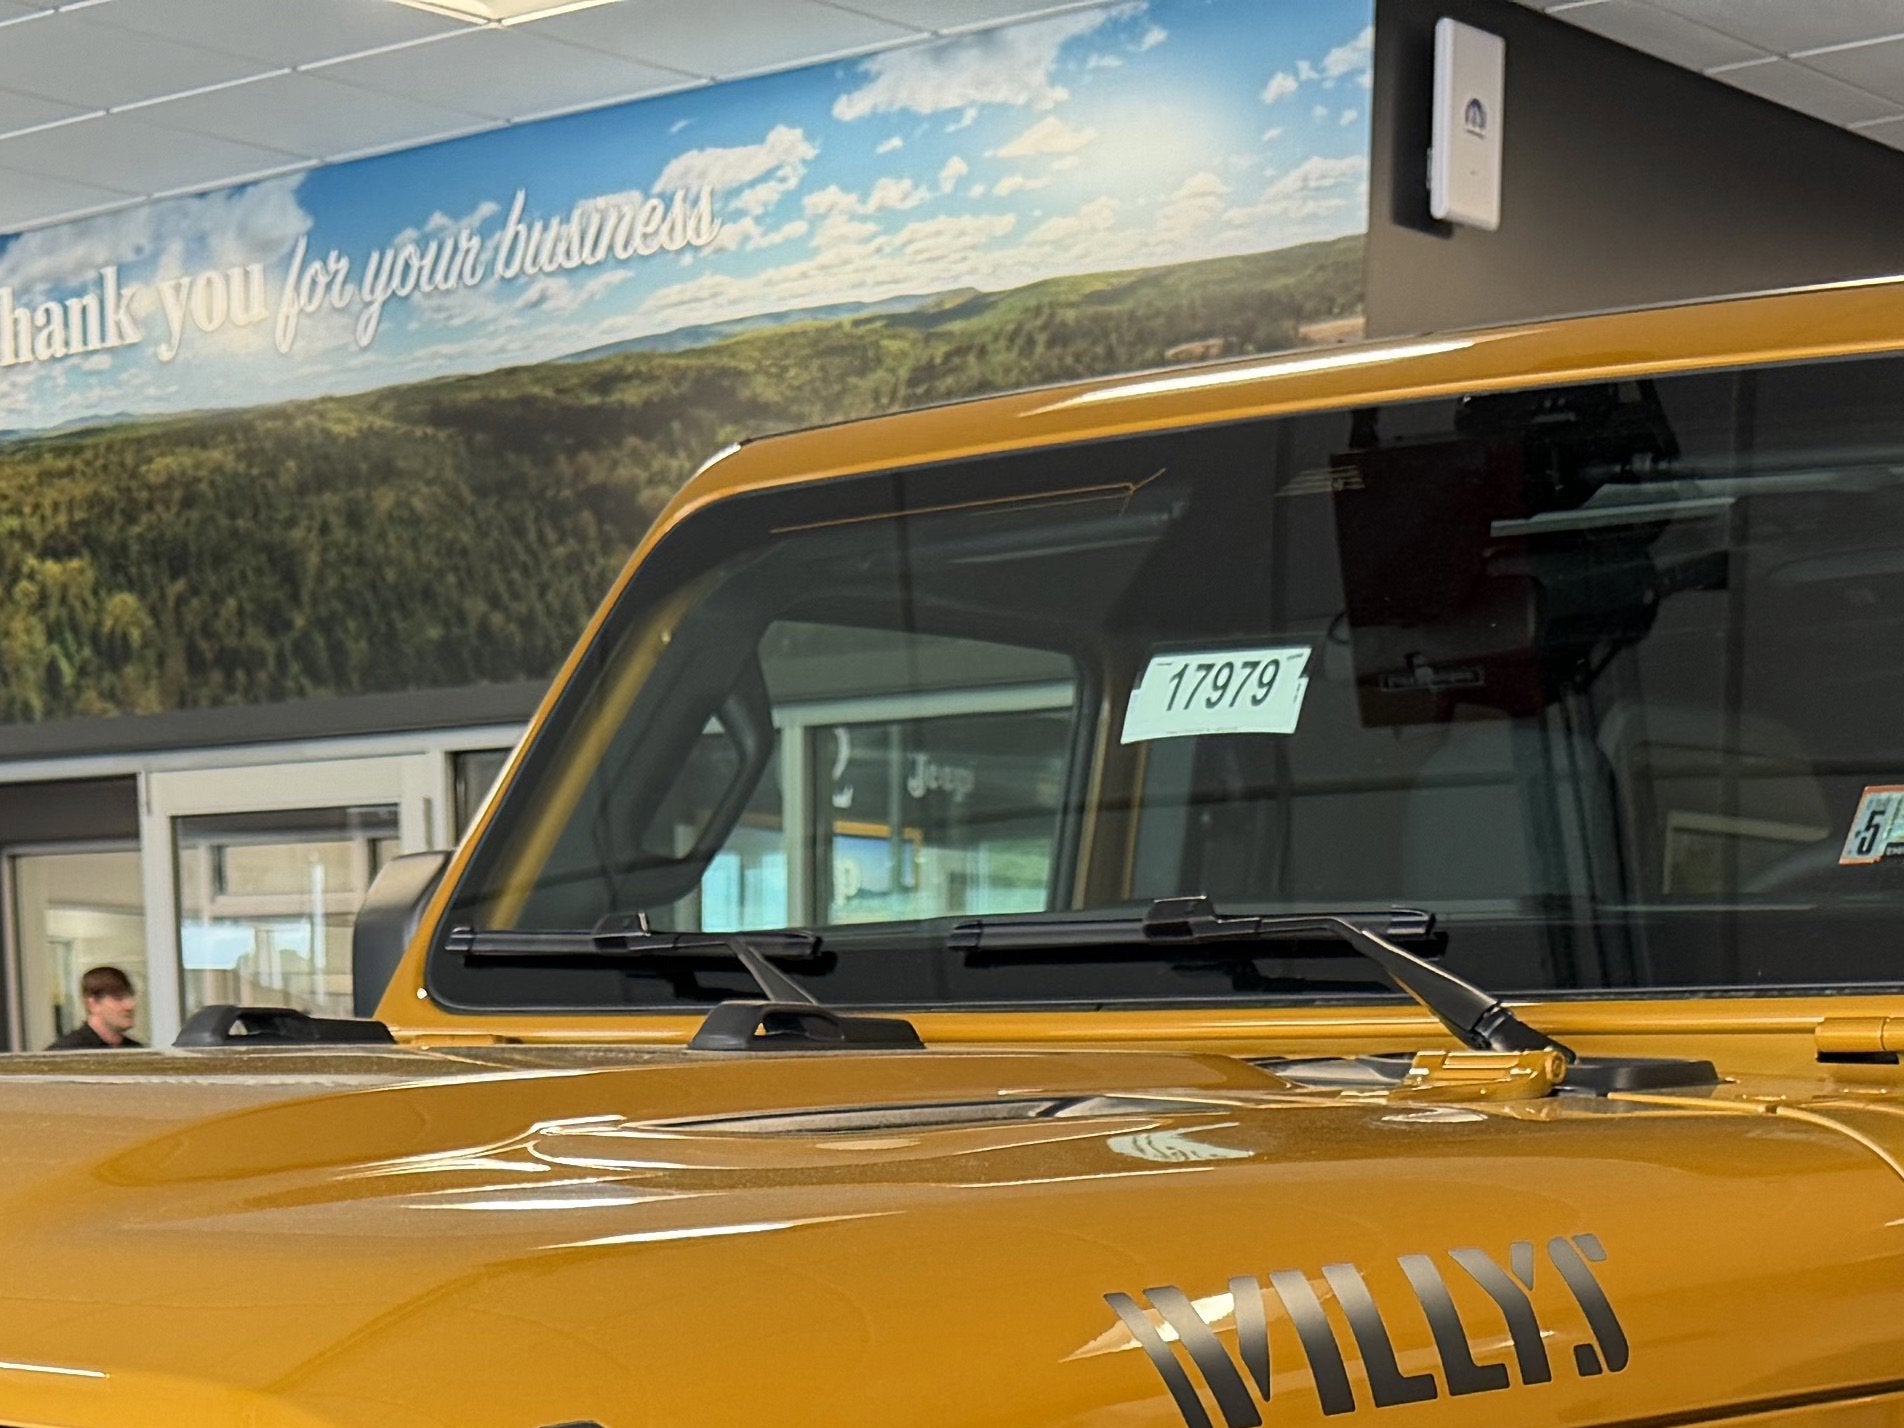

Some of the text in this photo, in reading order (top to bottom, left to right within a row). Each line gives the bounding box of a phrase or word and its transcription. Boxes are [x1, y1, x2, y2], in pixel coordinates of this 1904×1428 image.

[157, 261, 267, 362] you
[273, 233, 352, 354] for
[360, 225, 482, 347] your
[495, 188, 722, 284] business
[1165, 658, 1281, 712] 17979
[1857, 810, 1886, 856] 5
